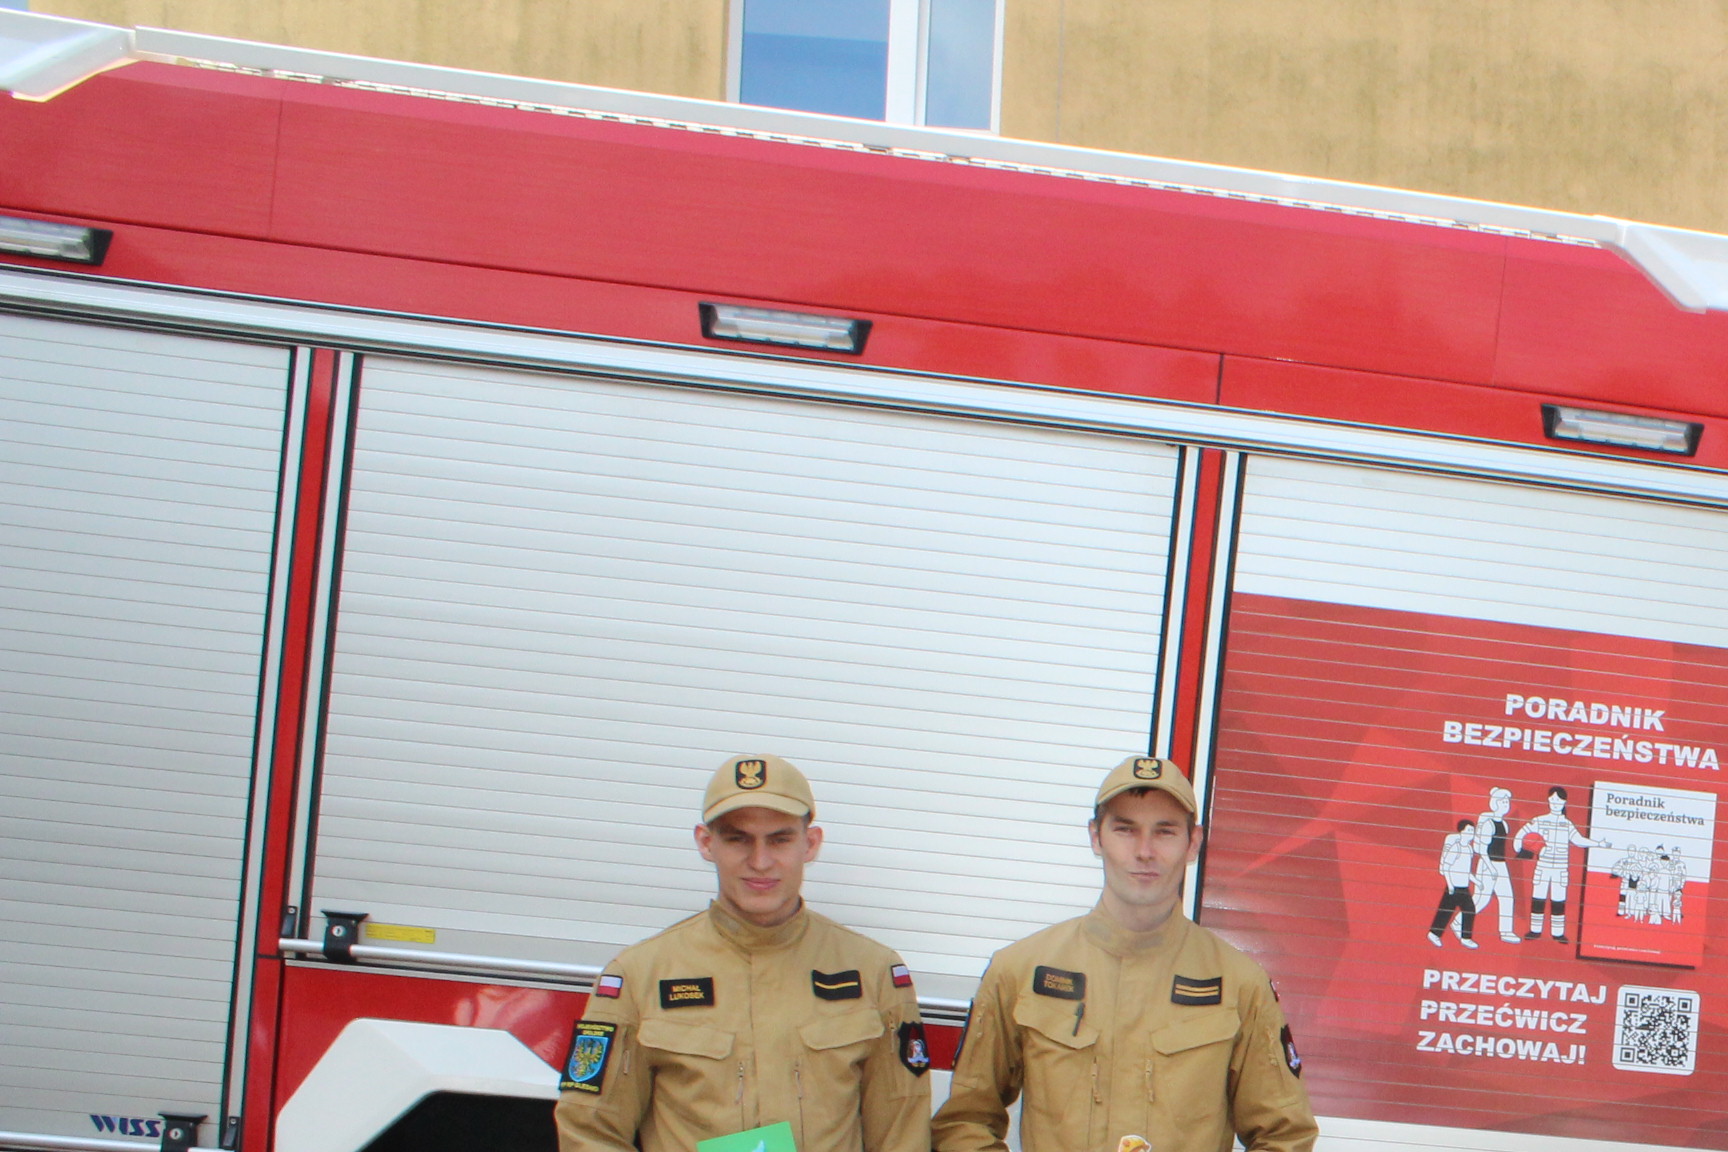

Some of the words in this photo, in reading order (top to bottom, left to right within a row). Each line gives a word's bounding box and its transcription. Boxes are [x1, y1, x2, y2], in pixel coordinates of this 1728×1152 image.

[1505, 694, 1666, 732] PORADNIK
[1443, 721, 1720, 770] BEZPIECZEŃSTWA
[1605, 805, 1705, 826] bezpieczeństwa
[1606, 793, 1665, 809] Poradnik
[1422, 969, 1607, 1005] PRZECZYTAJ
[1420, 1000, 1587, 1035] PRZEĆWICZ
[1416, 1031, 1586, 1065] ZACHOWAJ!
[90, 1114, 160, 1138] WISS
